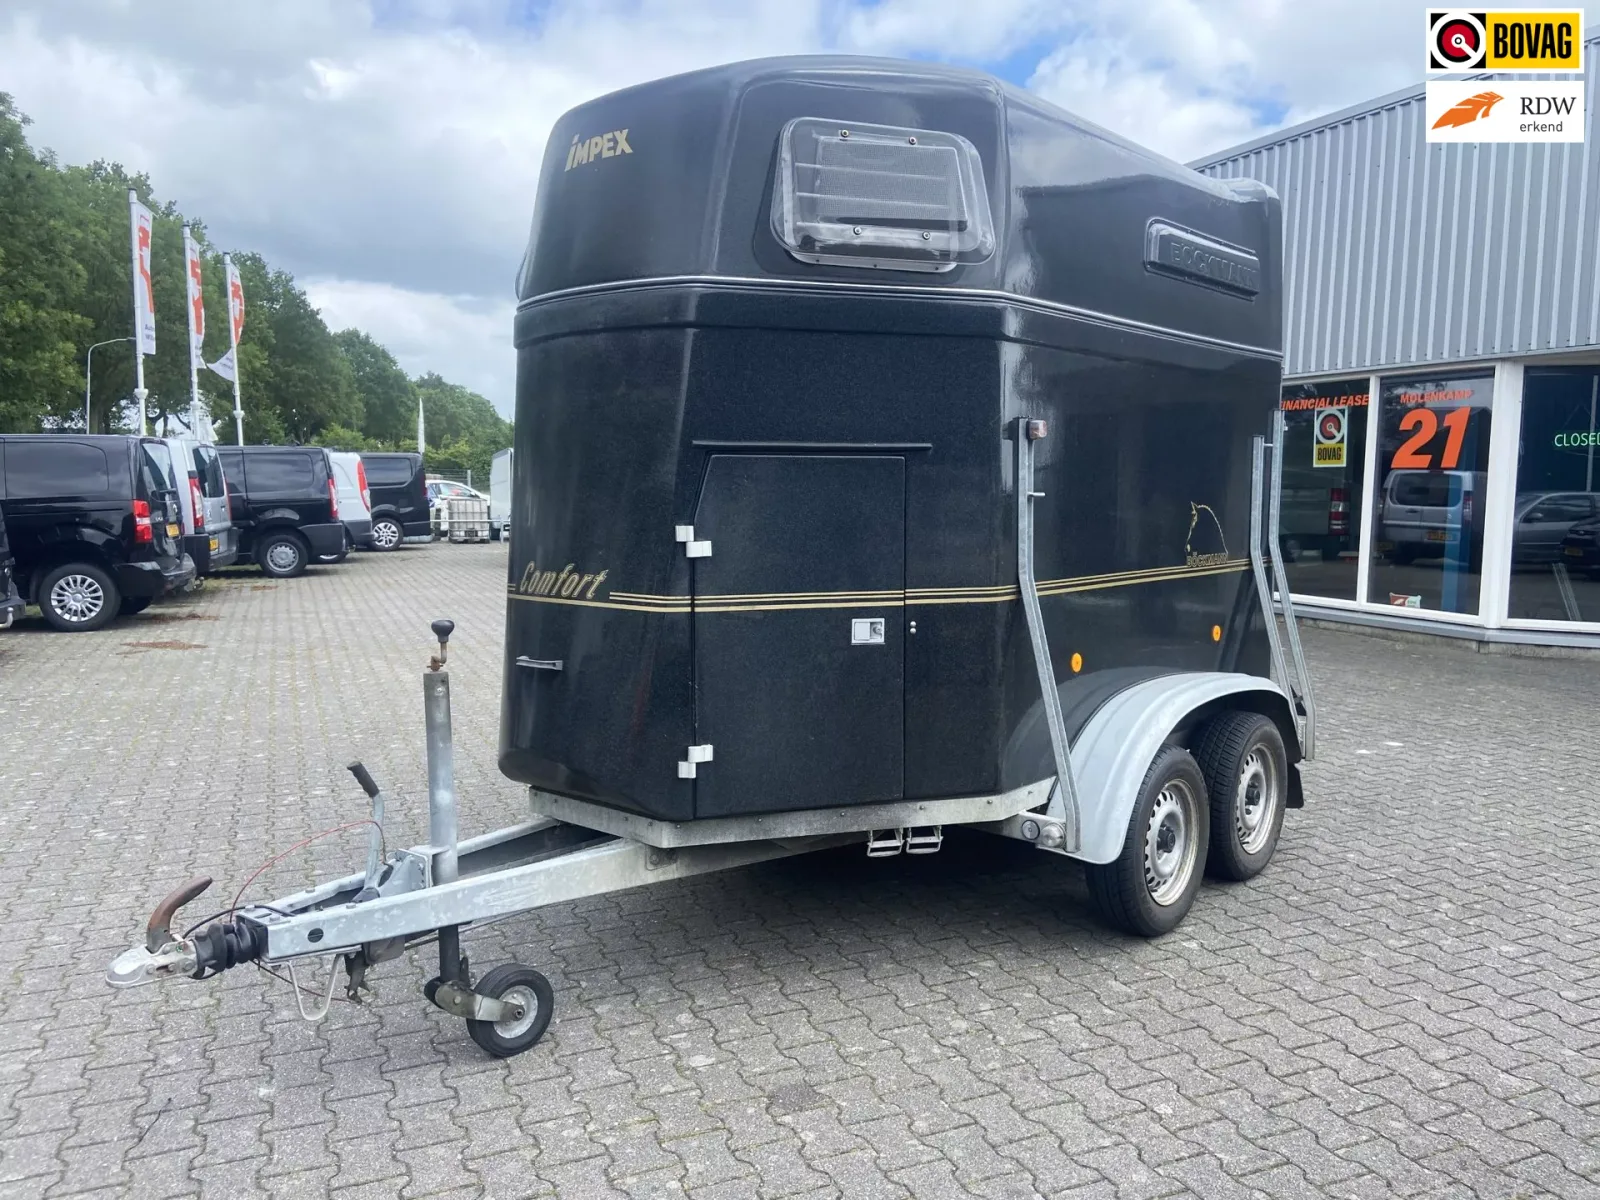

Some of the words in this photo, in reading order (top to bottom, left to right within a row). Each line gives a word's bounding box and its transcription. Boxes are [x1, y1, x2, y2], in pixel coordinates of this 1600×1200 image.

[1332, 393, 1370, 408] LEASE
[1400, 389, 1474, 404] MOLENKAMP
[1390, 405, 1472, 469] 21
[1317, 446, 1342, 461] BOVAG
[520, 560, 609, 600] Comfort
